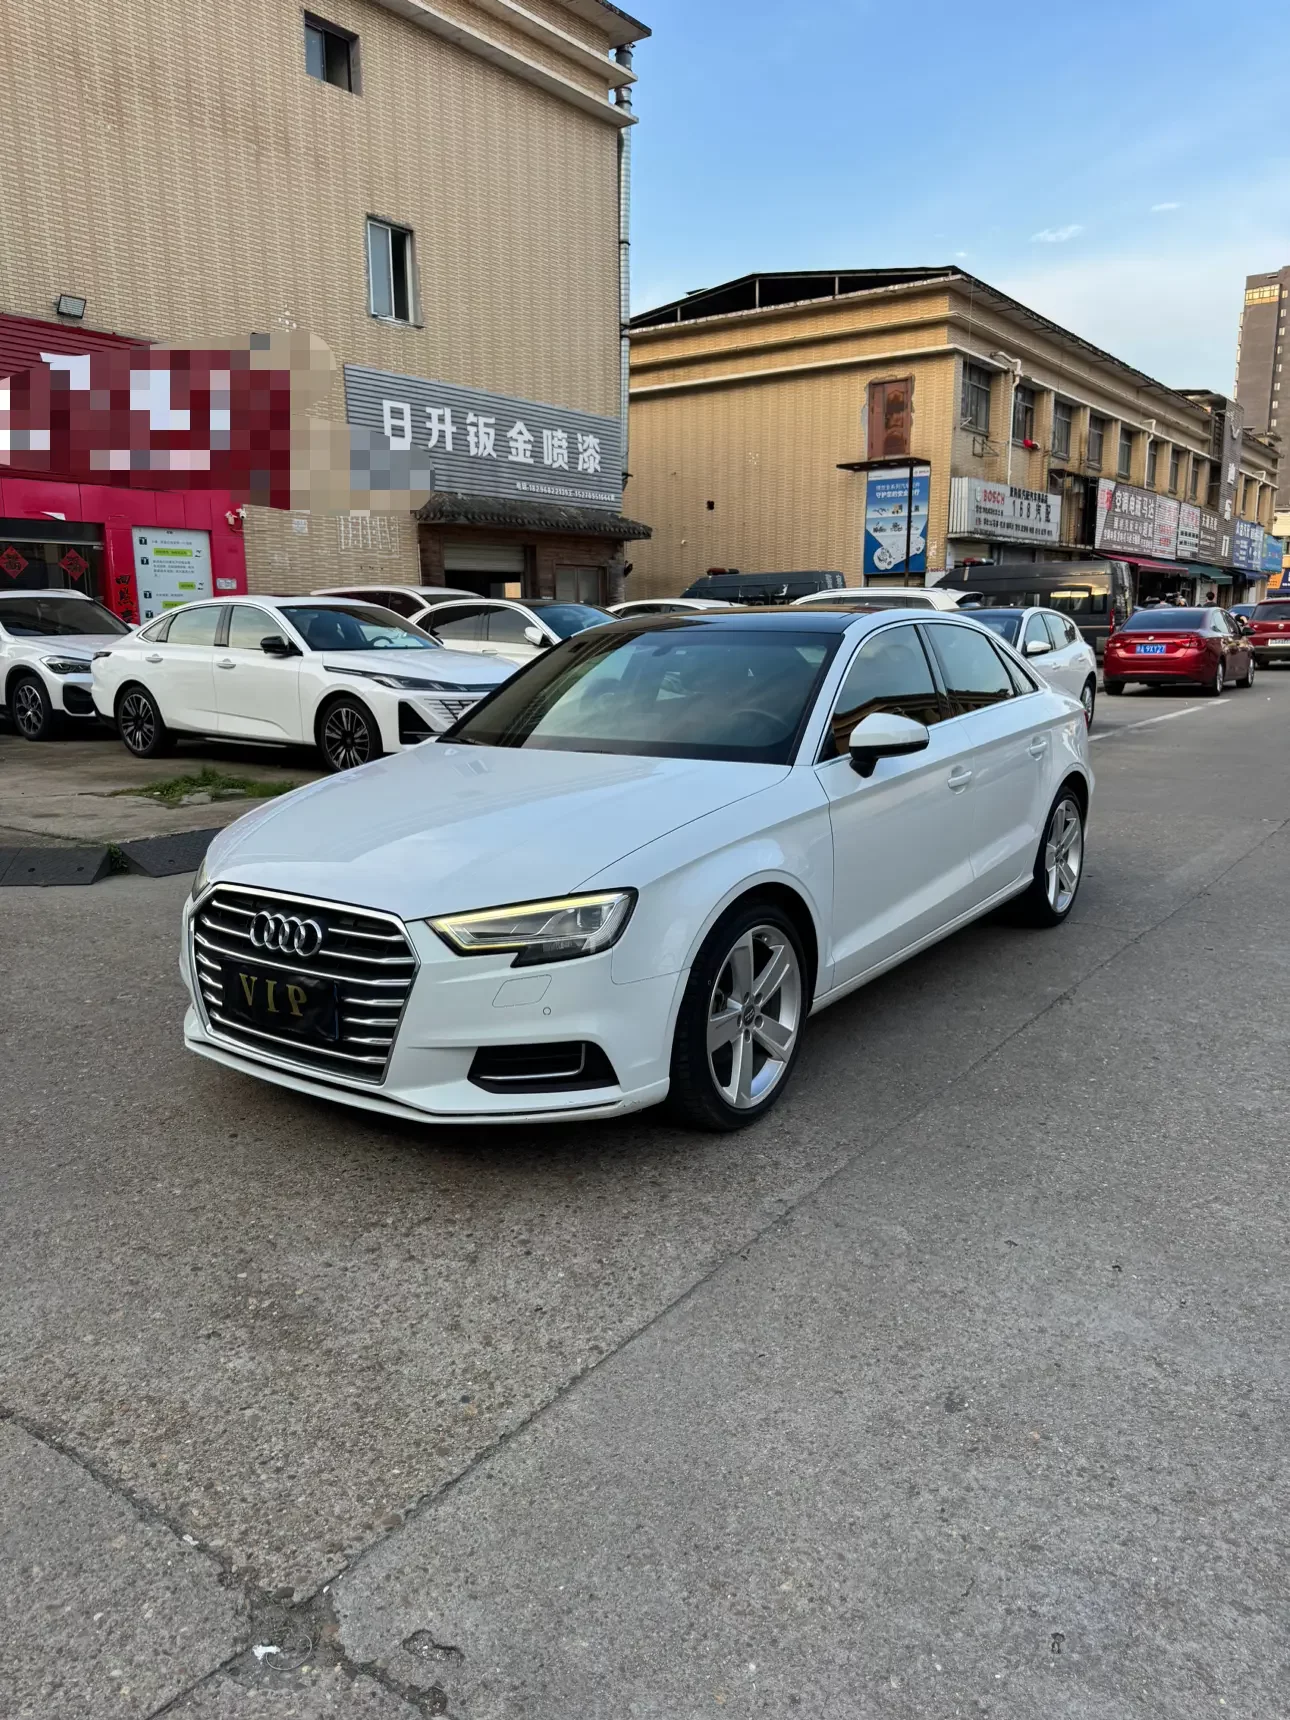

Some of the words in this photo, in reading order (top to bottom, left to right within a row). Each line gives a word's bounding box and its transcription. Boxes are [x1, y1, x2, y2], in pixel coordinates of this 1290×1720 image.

[382, 399, 602, 475] 日升钣金喷漆
[983, 489, 1005, 505] BOSCH
[238, 972, 308, 1017] VIP
